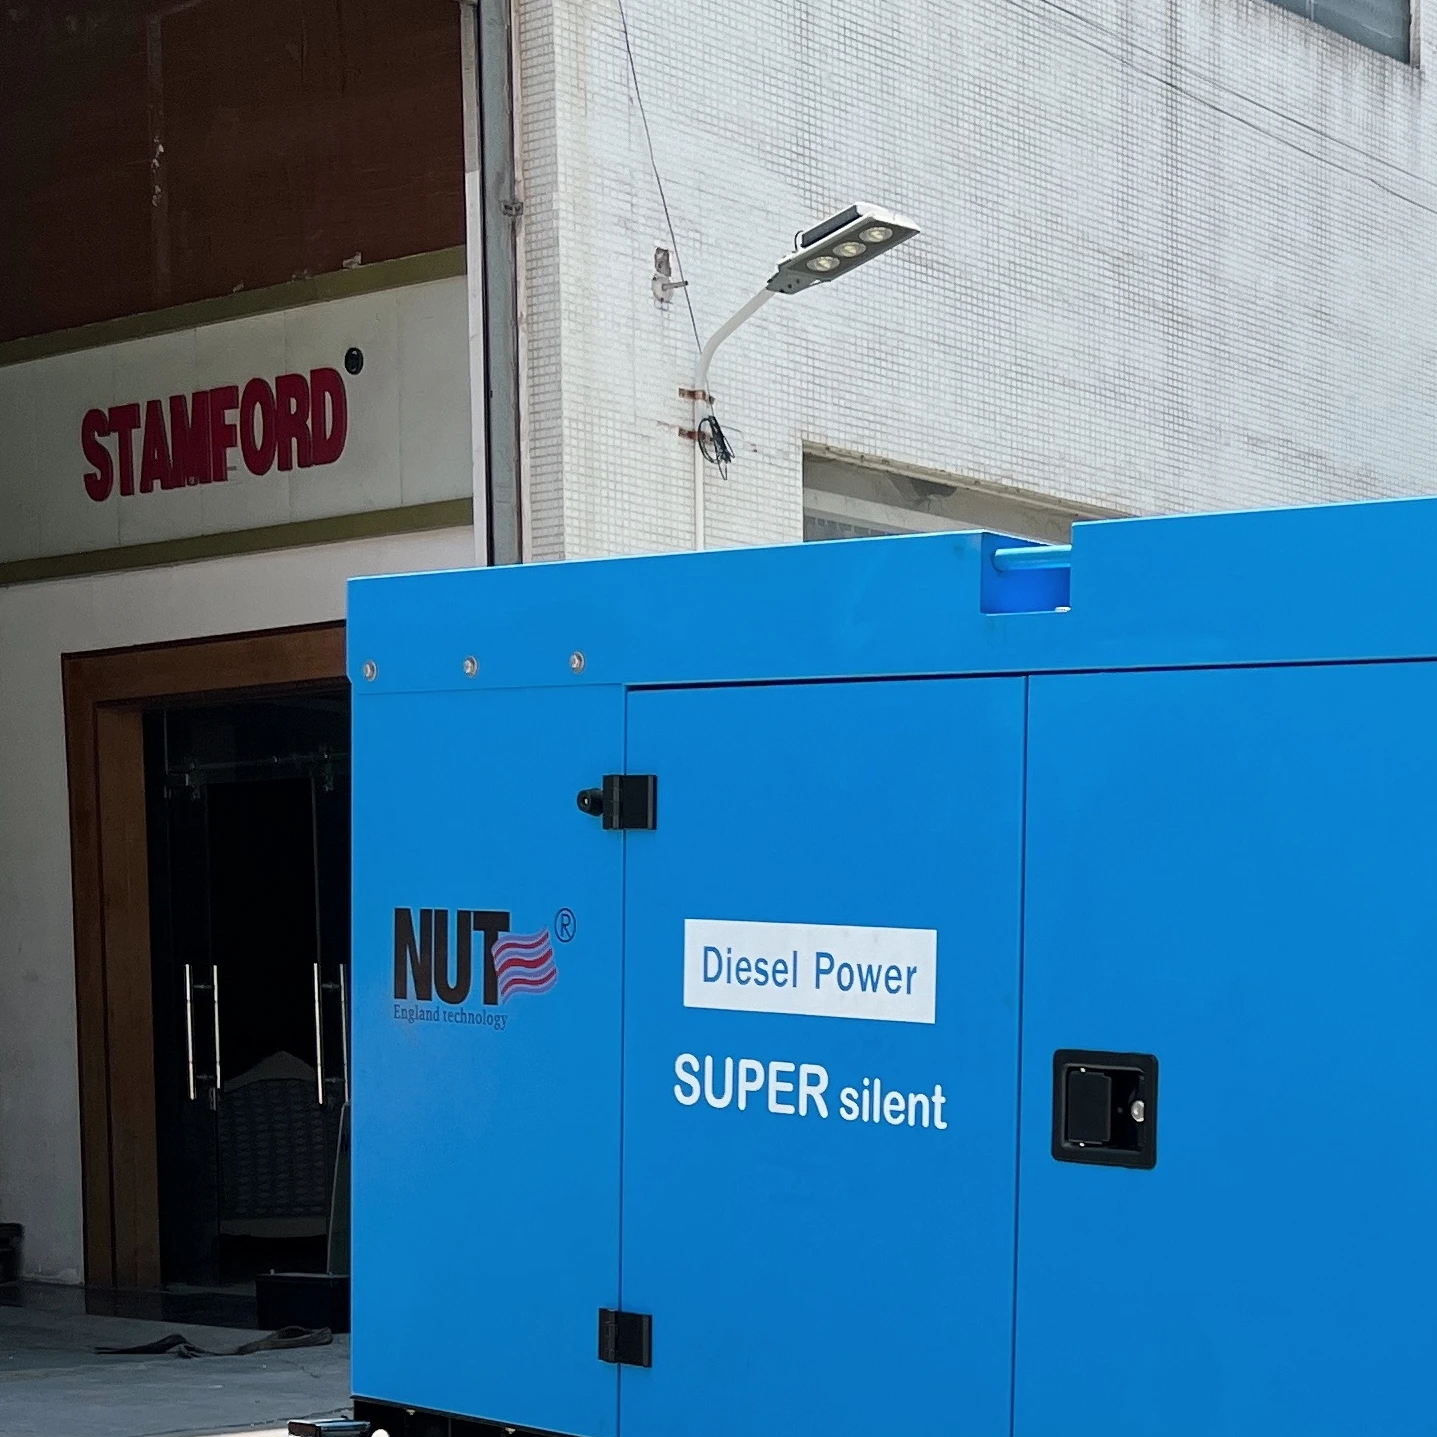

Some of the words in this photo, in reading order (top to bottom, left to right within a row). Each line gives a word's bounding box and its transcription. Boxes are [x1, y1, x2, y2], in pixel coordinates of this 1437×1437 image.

[81, 366, 348, 502] STAMFORD
[394, 907, 511, 1006] NUT
[703, 945, 798, 988] Diesel
[814, 951, 918, 995] Power
[393, 1004, 440, 1024] England
[442, 1009, 508, 1031] technology
[674, 1053, 829, 1119] SUPER
[839, 1077, 948, 1130] silent
